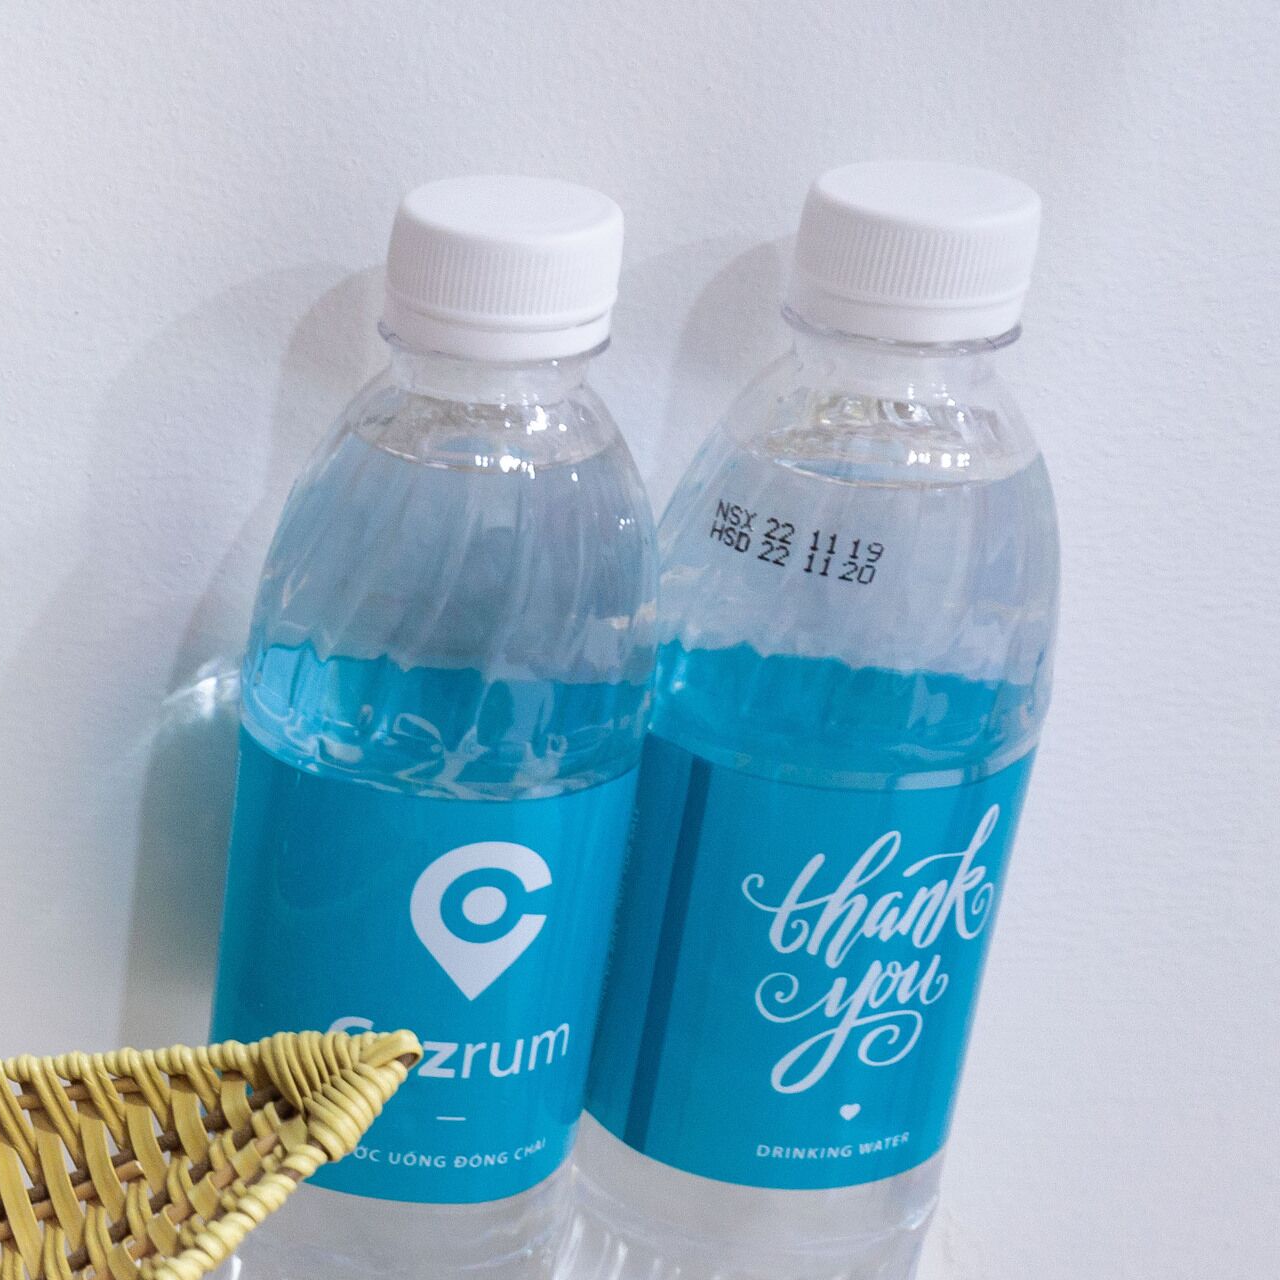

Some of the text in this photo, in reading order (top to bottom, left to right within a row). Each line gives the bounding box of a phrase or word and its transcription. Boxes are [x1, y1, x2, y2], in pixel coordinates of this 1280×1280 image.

[710, 520, 751, 553] HSD
[757, 541, 790, 567] 22
[838, 561, 876, 585] 20
[715, 499, 757, 532] NSX
[764, 518, 795, 545] 22
[849, 538, 884, 563] 19
[742, 804, 996, 968] thank
[755, 954, 949, 1094] you
[514, 1136, 546, 1161] CHAI
[756, 1131, 910, 1160] DRINKING WATER
